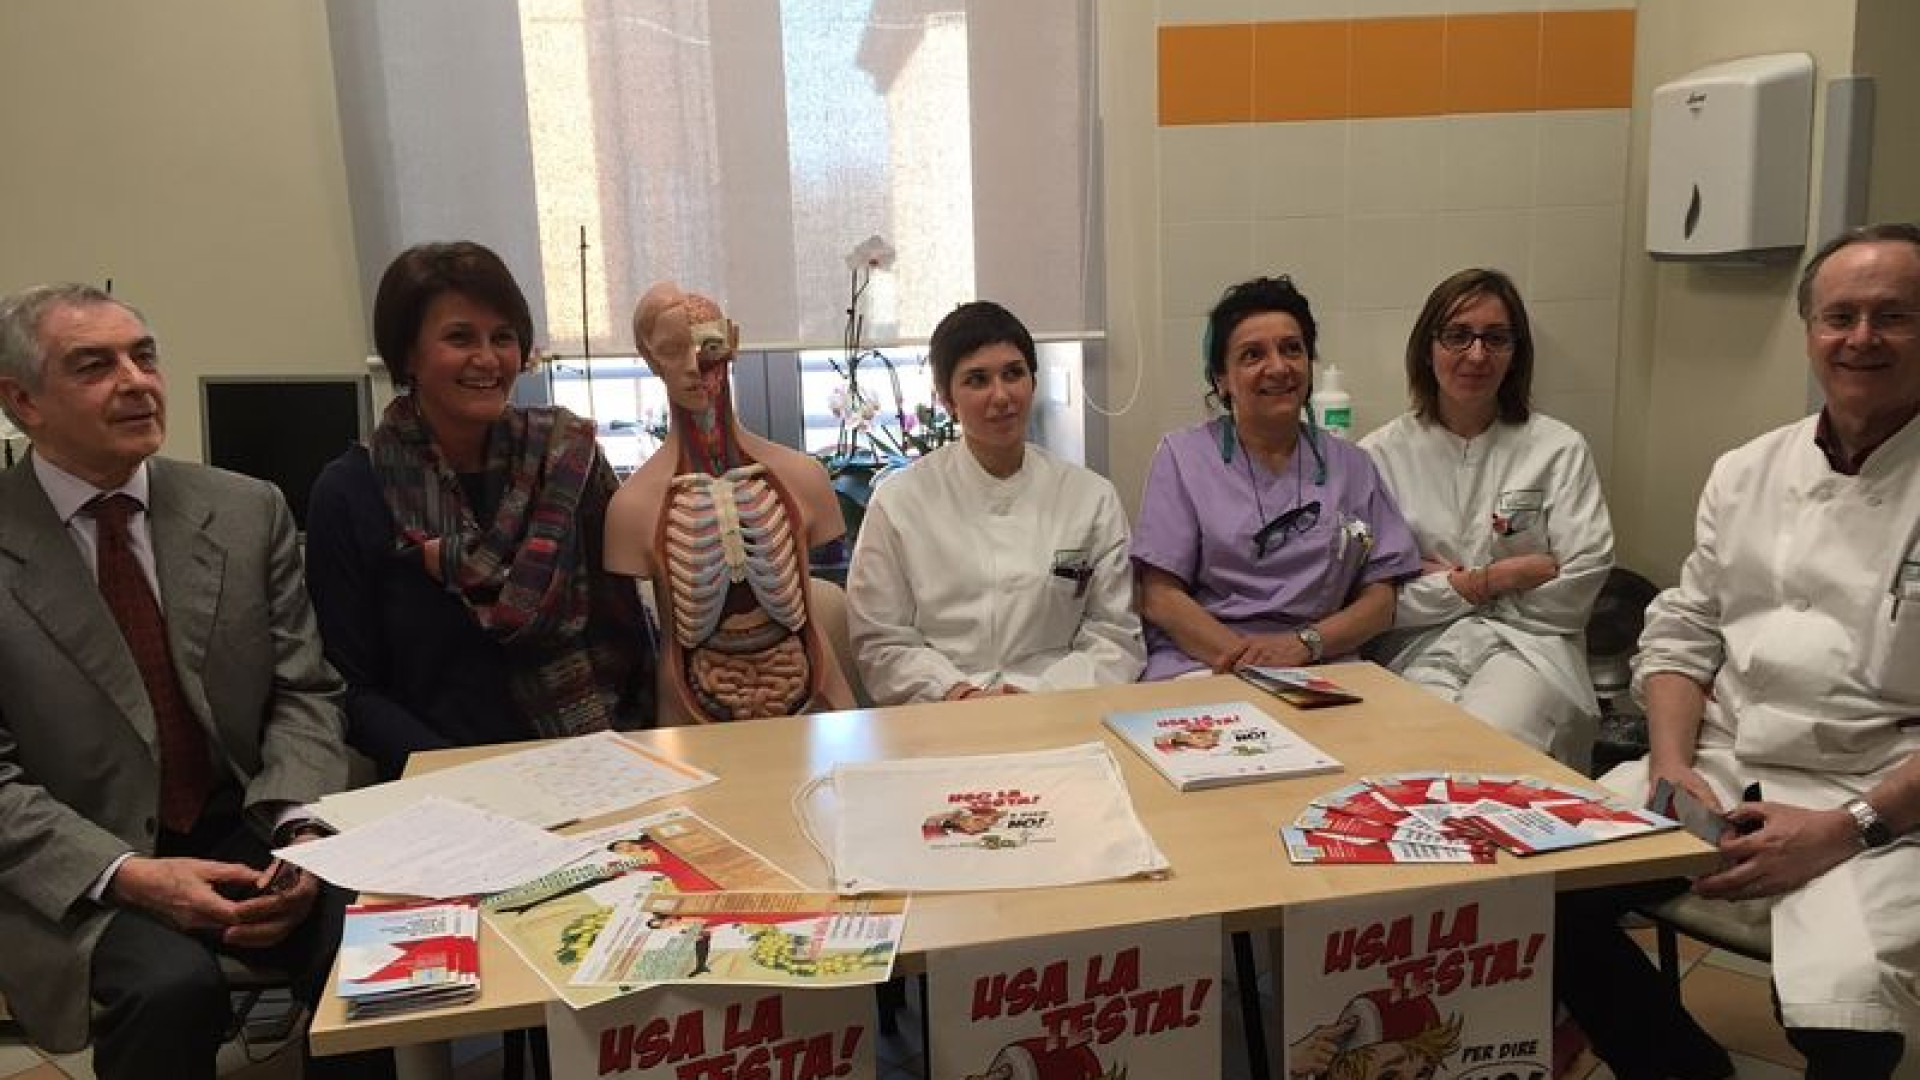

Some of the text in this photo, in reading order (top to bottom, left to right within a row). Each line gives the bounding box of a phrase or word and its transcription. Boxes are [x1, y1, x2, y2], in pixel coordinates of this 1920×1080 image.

[1324, 902, 1479, 975] USA LA
[1386, 933, 1546, 998] TESTA!
[972, 946, 1140, 1023] USA LA
[1041, 978, 1213, 1049] TESTA!
[597, 993, 782, 1076] USA LA
[1462, 1040, 1538, 1063] PER DIRE
